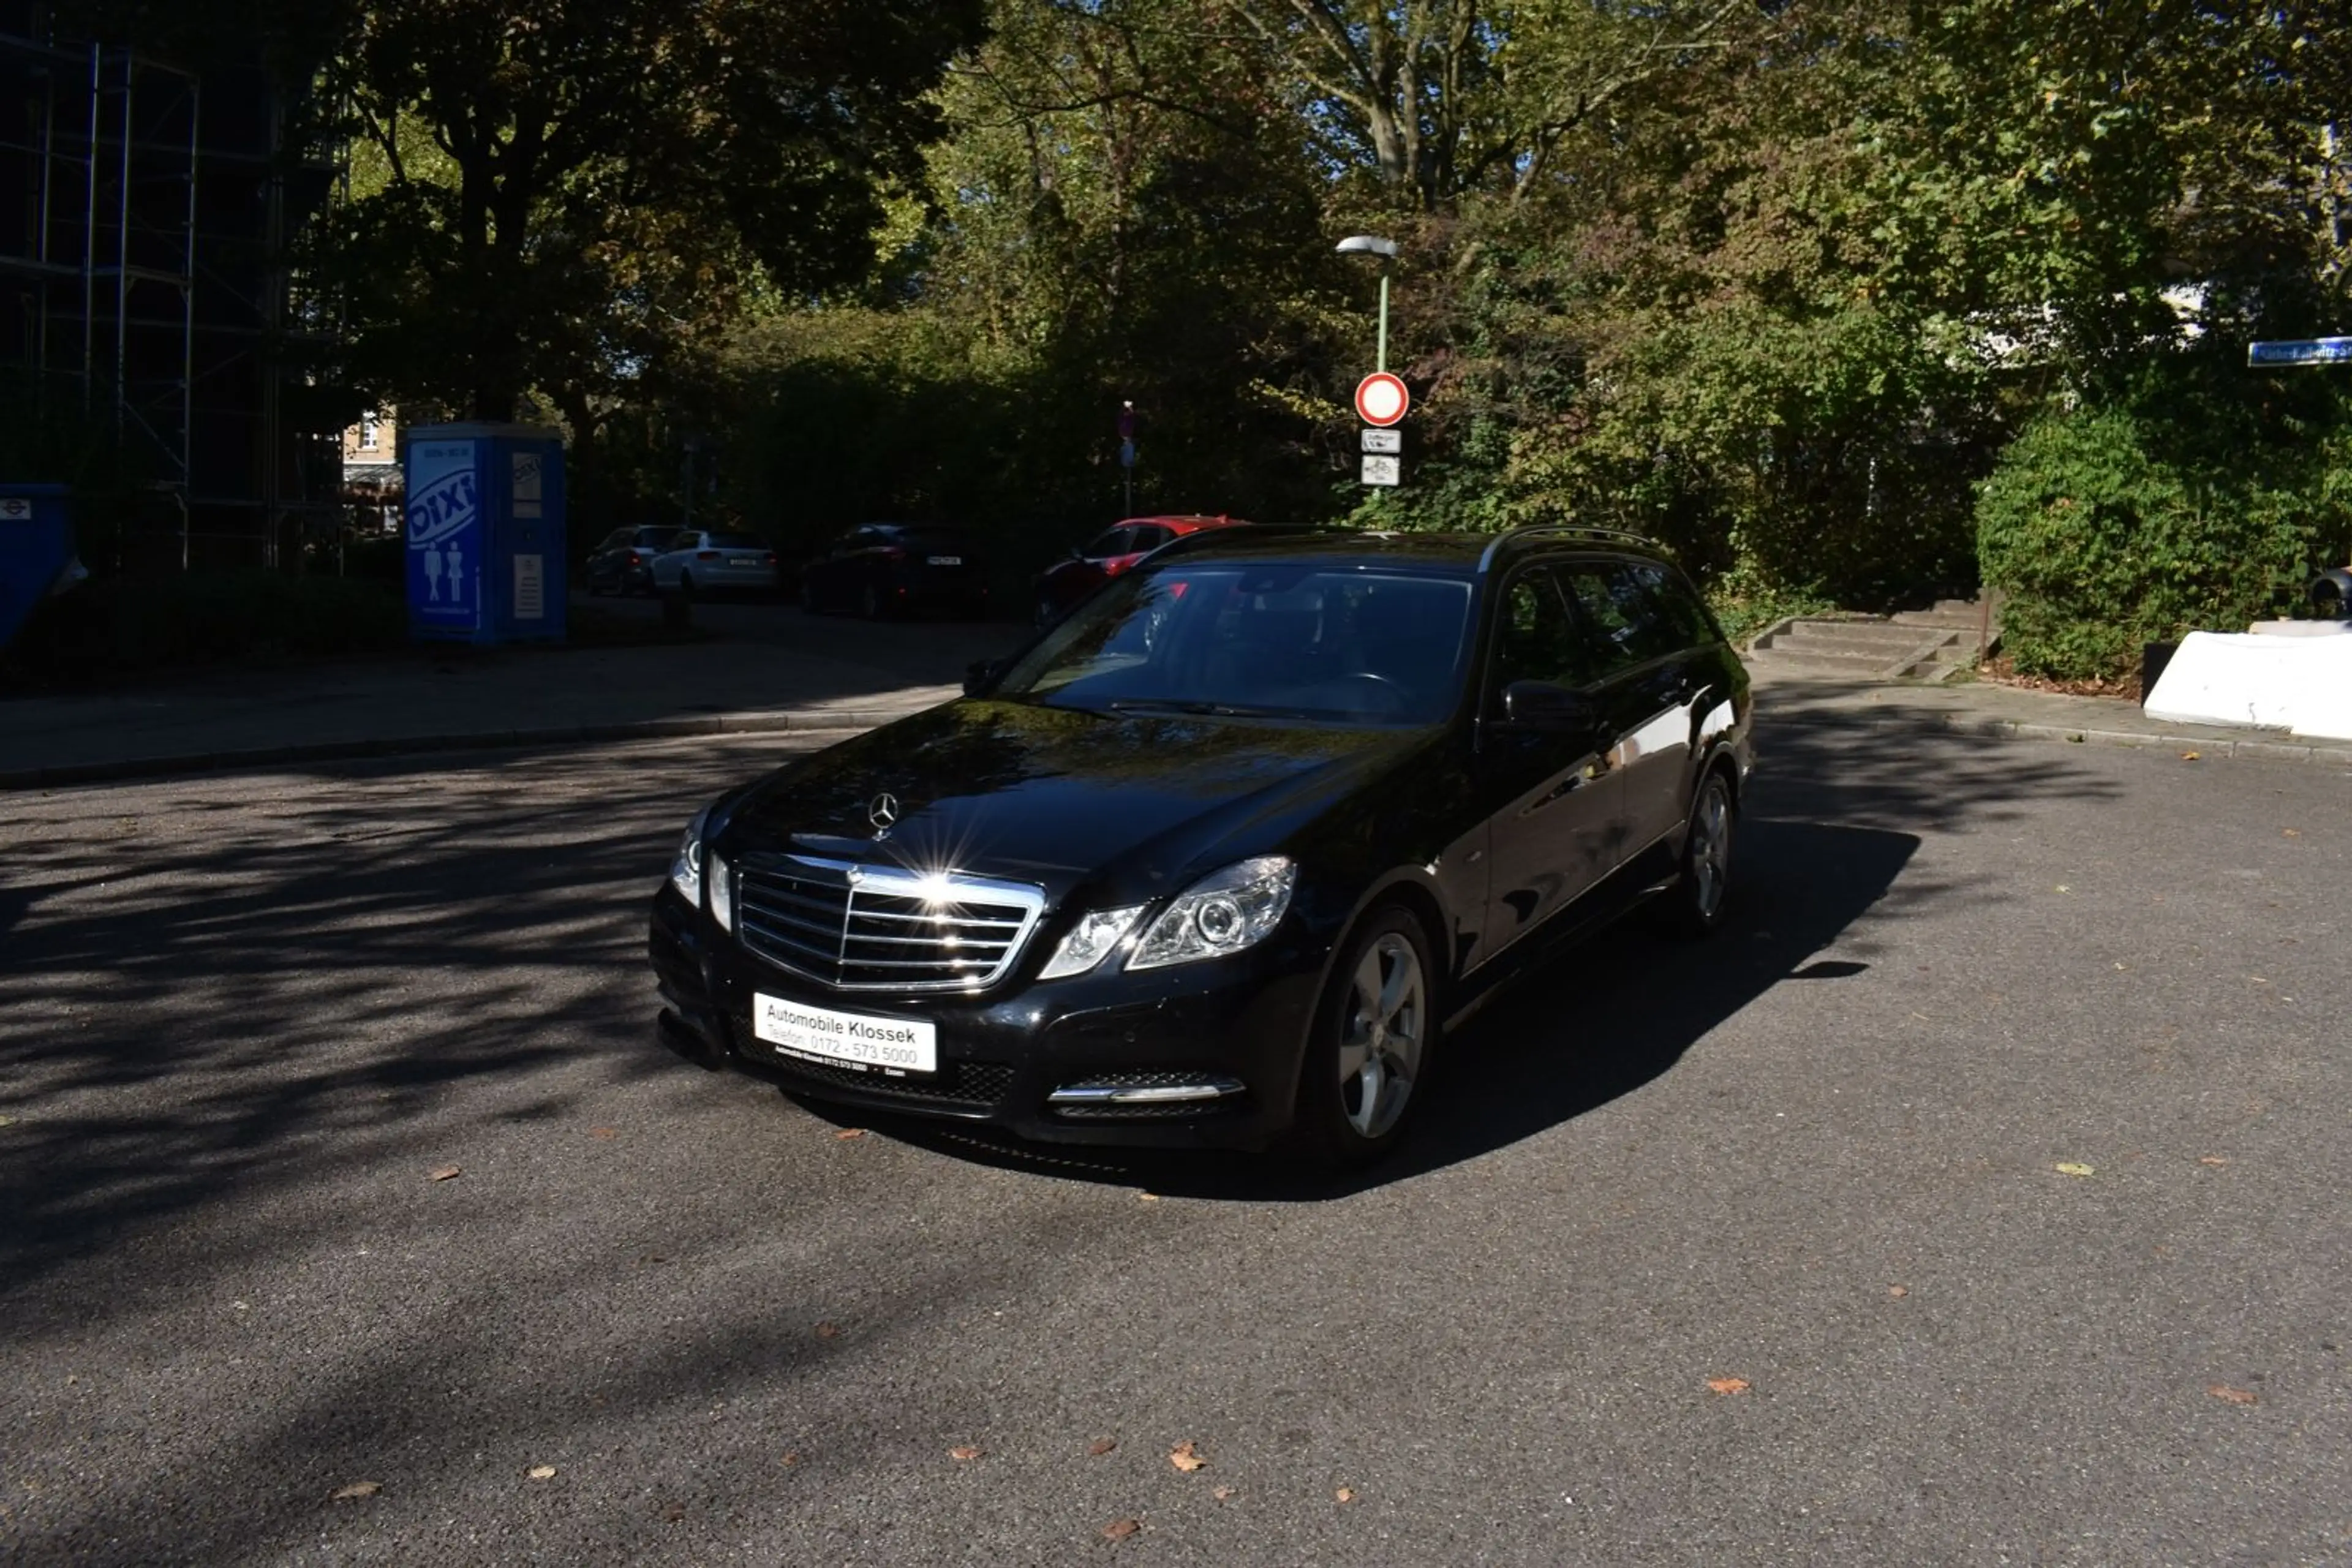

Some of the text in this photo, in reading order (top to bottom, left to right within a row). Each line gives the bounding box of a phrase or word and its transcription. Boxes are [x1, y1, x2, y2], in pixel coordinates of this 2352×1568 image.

[767, 1005, 916, 1044] Automobile Klossek
[811, 1035, 841, 1054] 0172
[853, 1043, 878, 1060] 573
[882, 1047, 918, 1064] 5000
